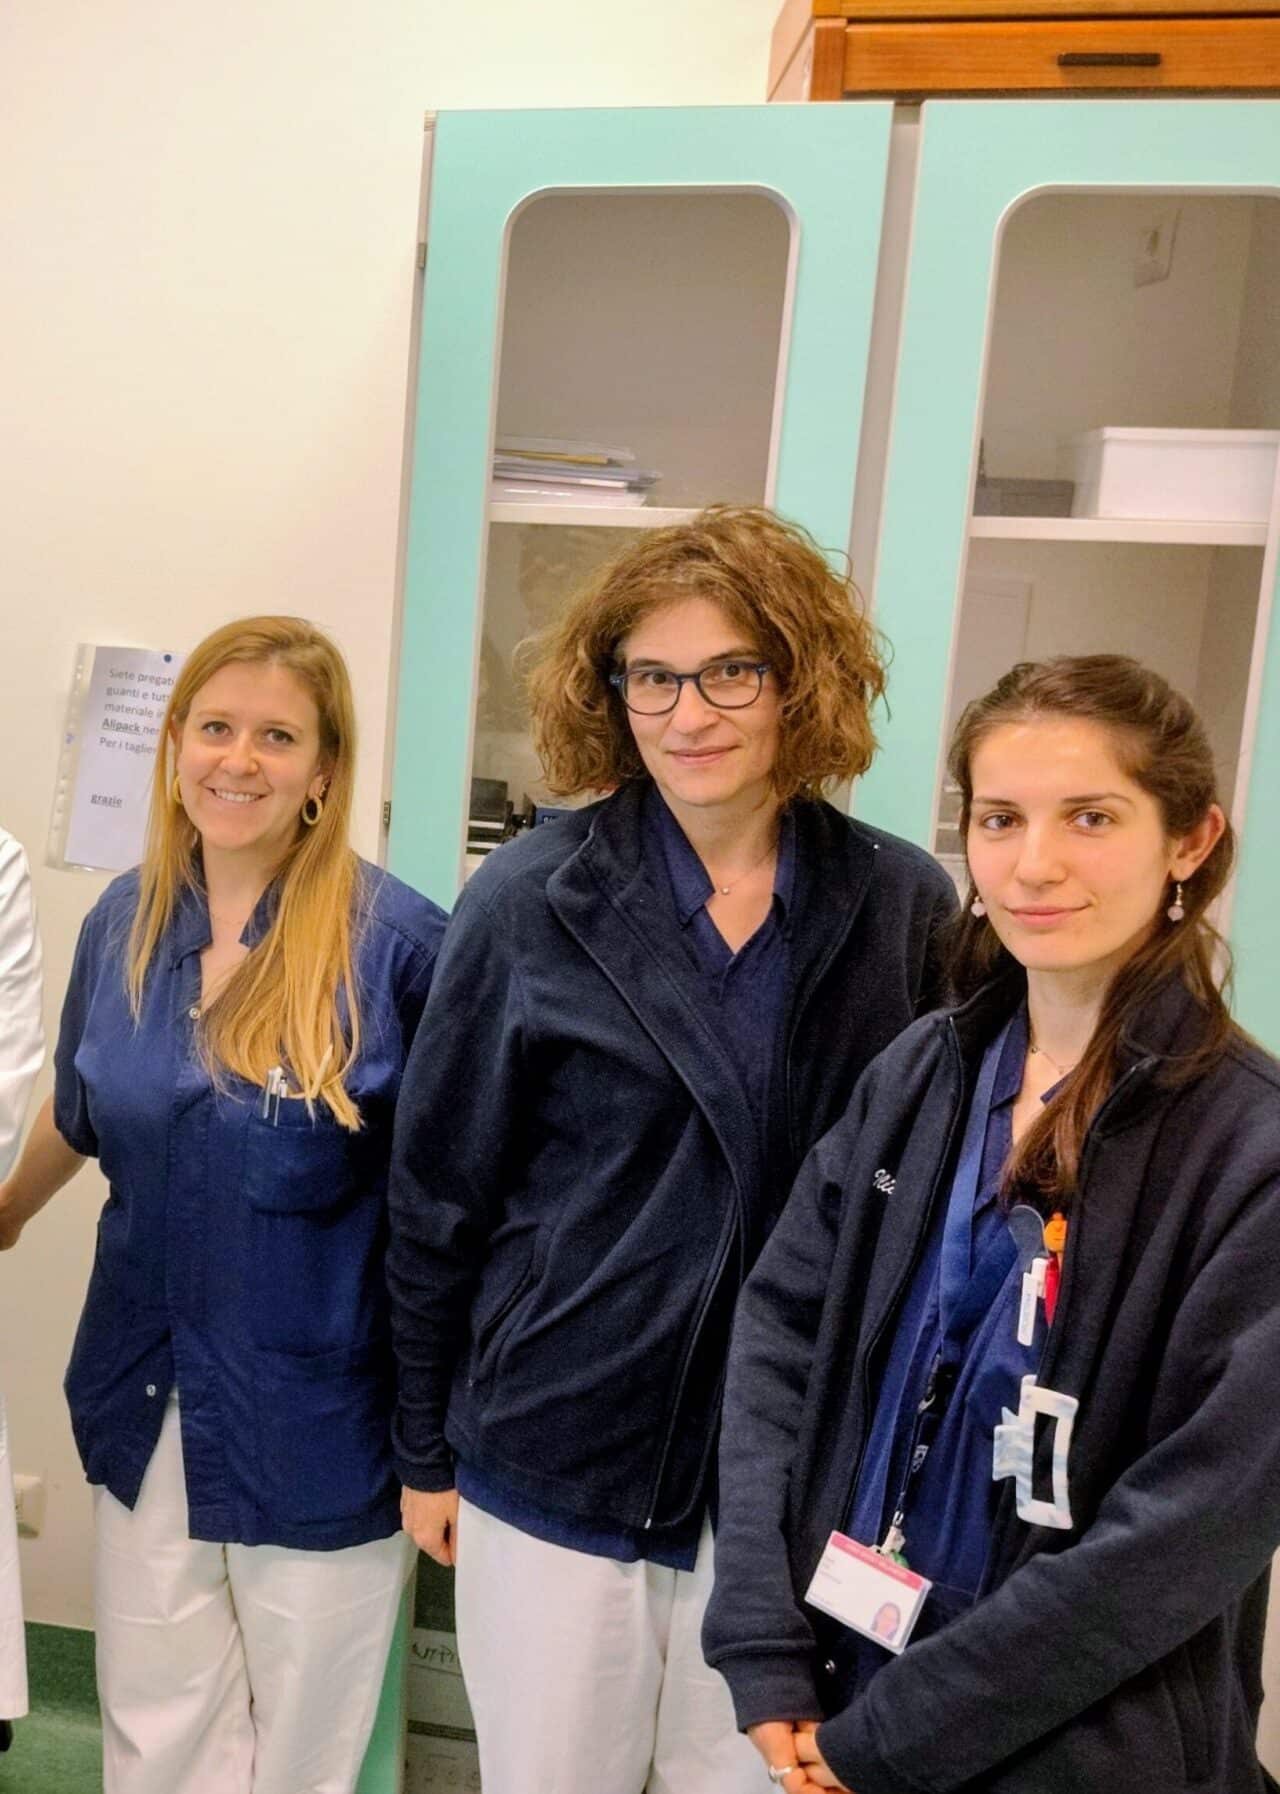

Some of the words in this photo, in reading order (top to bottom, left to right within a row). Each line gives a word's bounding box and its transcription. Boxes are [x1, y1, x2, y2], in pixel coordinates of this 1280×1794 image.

[109, 668, 136, 681] Siete
[106, 687, 140, 699] guanti
[142, 691, 149, 700] e
[104, 703, 154, 718] materiale
[102, 717, 141, 735] Alipack
[100, 736, 117, 748] Per
[90, 794, 123, 809] grazie
